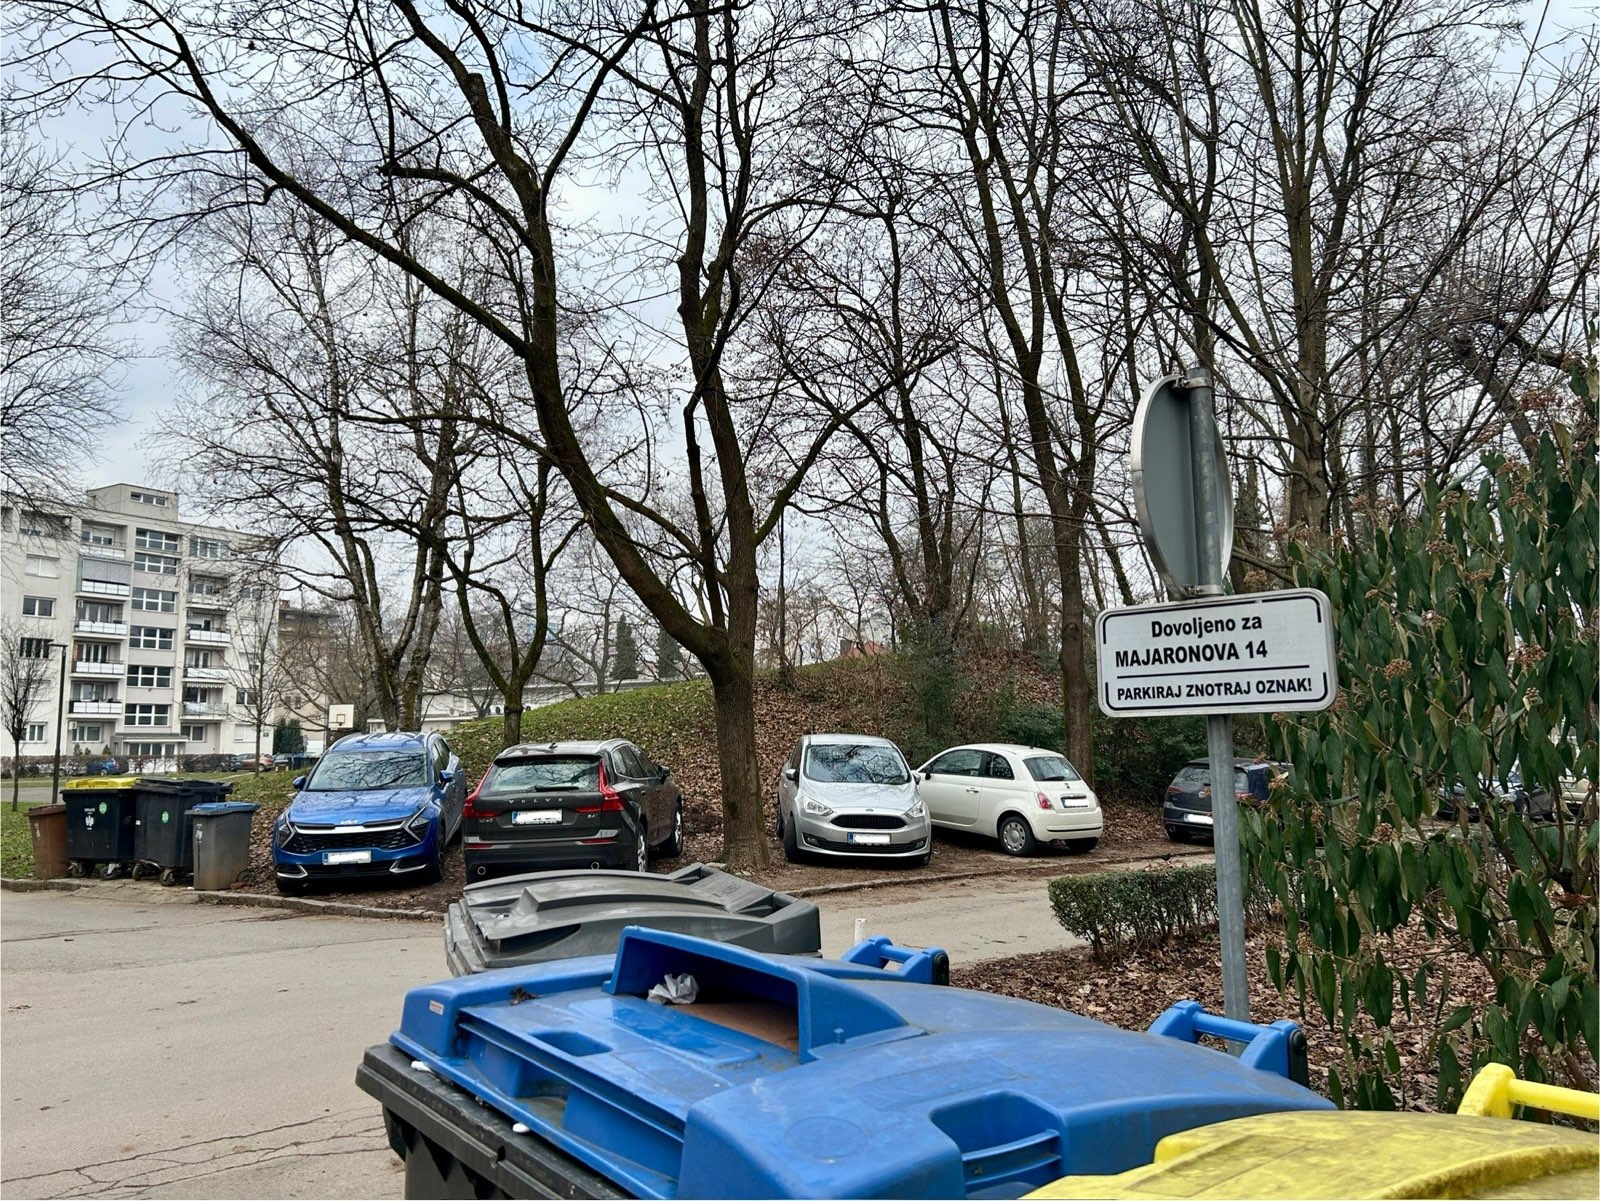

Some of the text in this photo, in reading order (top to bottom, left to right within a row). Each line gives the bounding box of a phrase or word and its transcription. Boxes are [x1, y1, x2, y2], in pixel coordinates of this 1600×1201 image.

[1151, 616, 1262, 638] Dovoljeno za
[1115, 640, 1268, 667] MAJARONOVA 14
[1117, 678, 1312, 700] PARKIRAJ ZNOTRAJ OZNAK!
